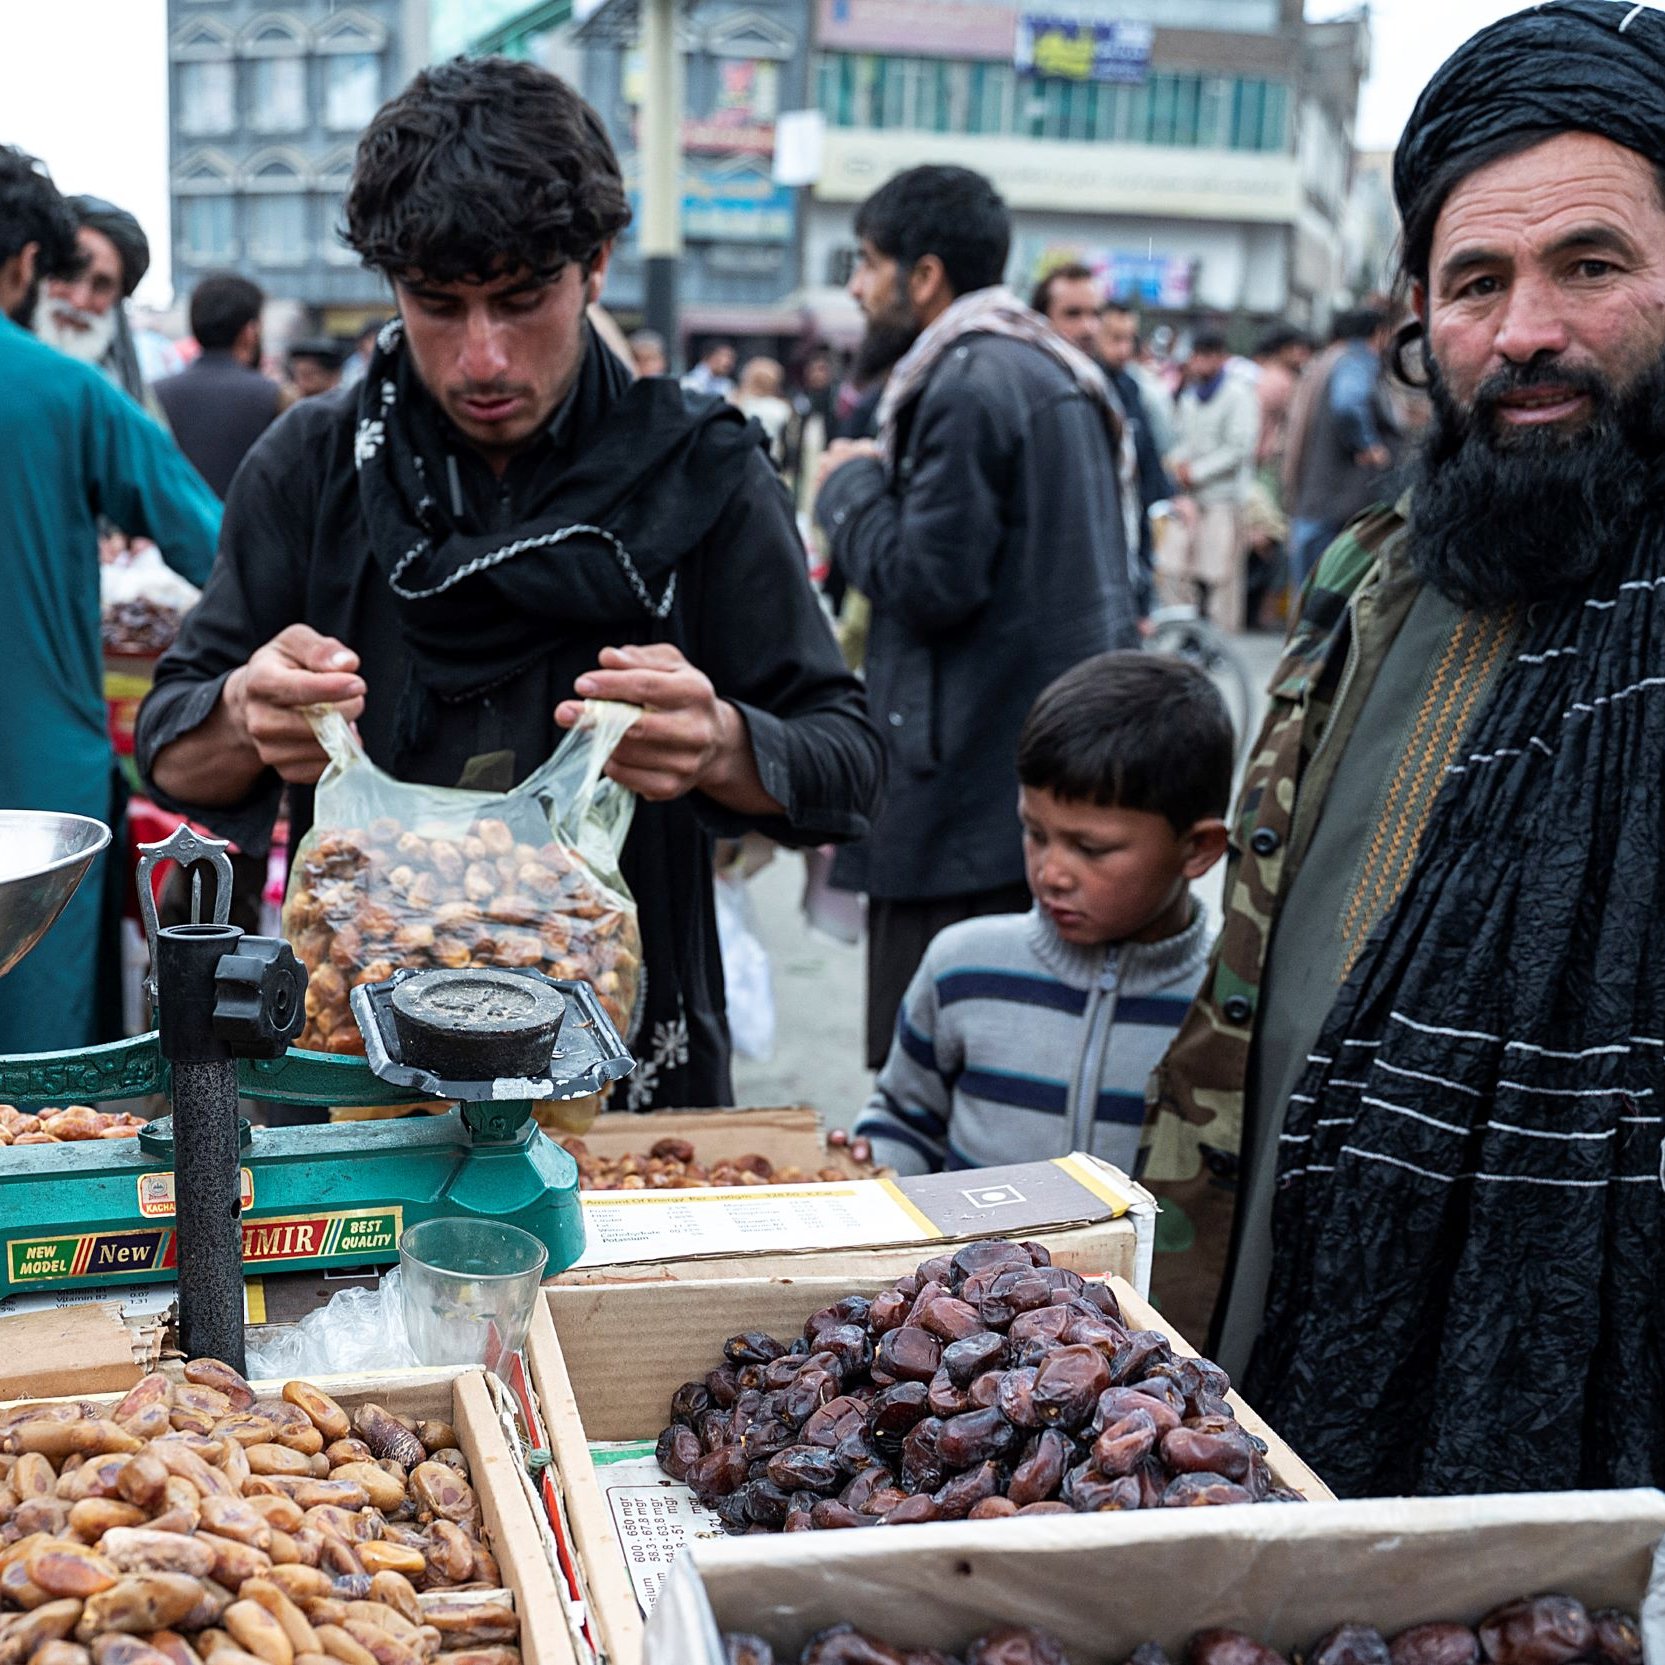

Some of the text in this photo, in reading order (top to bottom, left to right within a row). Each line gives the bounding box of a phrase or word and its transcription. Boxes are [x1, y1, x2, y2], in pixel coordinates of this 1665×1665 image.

[146, 1202, 176, 1214] KACHA
[350, 1219, 383, 1234] BEST
[242, 1224, 315, 1257] HMIR
[341, 1233, 392, 1250] QUALITY
[26, 1245, 57, 1260] NEW
[98, 1243, 152, 1265] New
[20, 1259, 67, 1275] MODEL
[56, 1293, 94, 1303] Vitamin
[129, 1291, 150, 1299] 0.07
[619, 1496, 633, 1517] mgr
[634, 1498, 647, 1516] mgr
[650, 1497, 663, 1516] mgr
[663, 1496, 678, 1514] mgr
[688, 1496, 703, 1514] mgr
[623, 1519, 638, 1537] 650
[638, 1517, 653, 1536] 67.8
[654, 1517, 669, 1536] 63.8
[669, 1524, 684, 1535] 51
[631, 1545, 646, 1563] 600
[646, 1543, 661, 1562] 58.3
